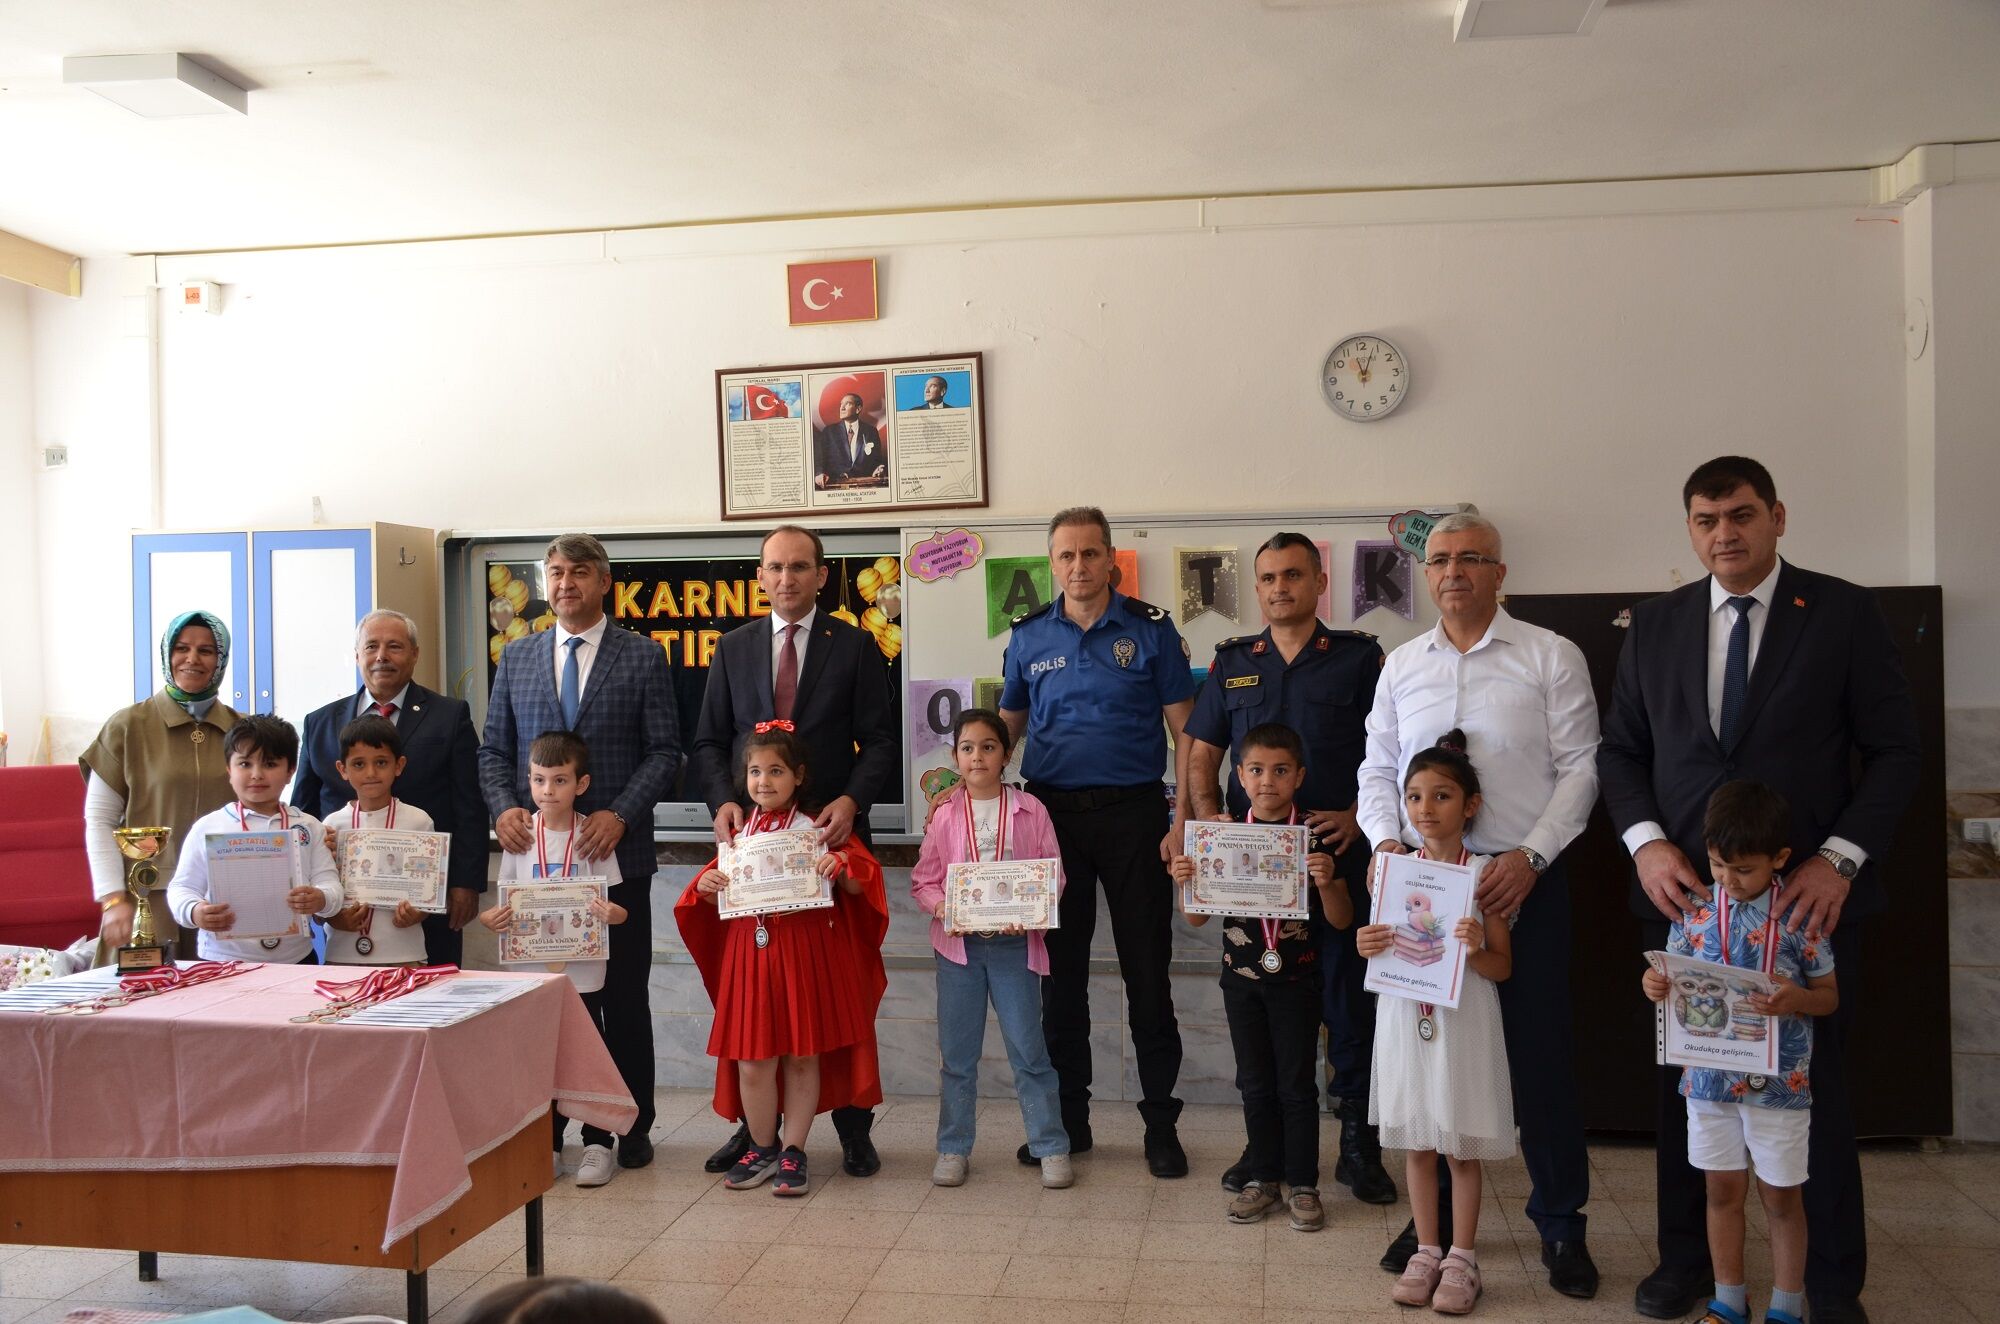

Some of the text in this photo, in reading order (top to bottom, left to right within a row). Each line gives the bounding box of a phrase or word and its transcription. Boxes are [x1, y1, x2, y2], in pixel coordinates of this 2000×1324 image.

[1355, 342, 1367, 351] 12
[1342, 348, 1350, 357] 11
[1385, 353, 1393, 362] 2
[1333, 360, 1344, 369] 10
[1392, 368, 1400, 377] 3
[1329, 376, 1338, 386] 9
[1389, 384, 1396, 392] 4
[1335, 391, 1344, 400] 8
[1380, 395, 1388, 405] 5
[1346, 400, 1354, 409] 7
[1363, 401, 1372, 411] 6
[1411, 517, 1428, 533] HEM
[1404, 531, 1422, 547] HEM
[920, 547, 943, 560] OKUYORUM
[614, 579, 773, 619] KARNE
[1380, 971, 1410, 983] Okudukça
[1684, 1043, 1720, 1054] Okudukça
